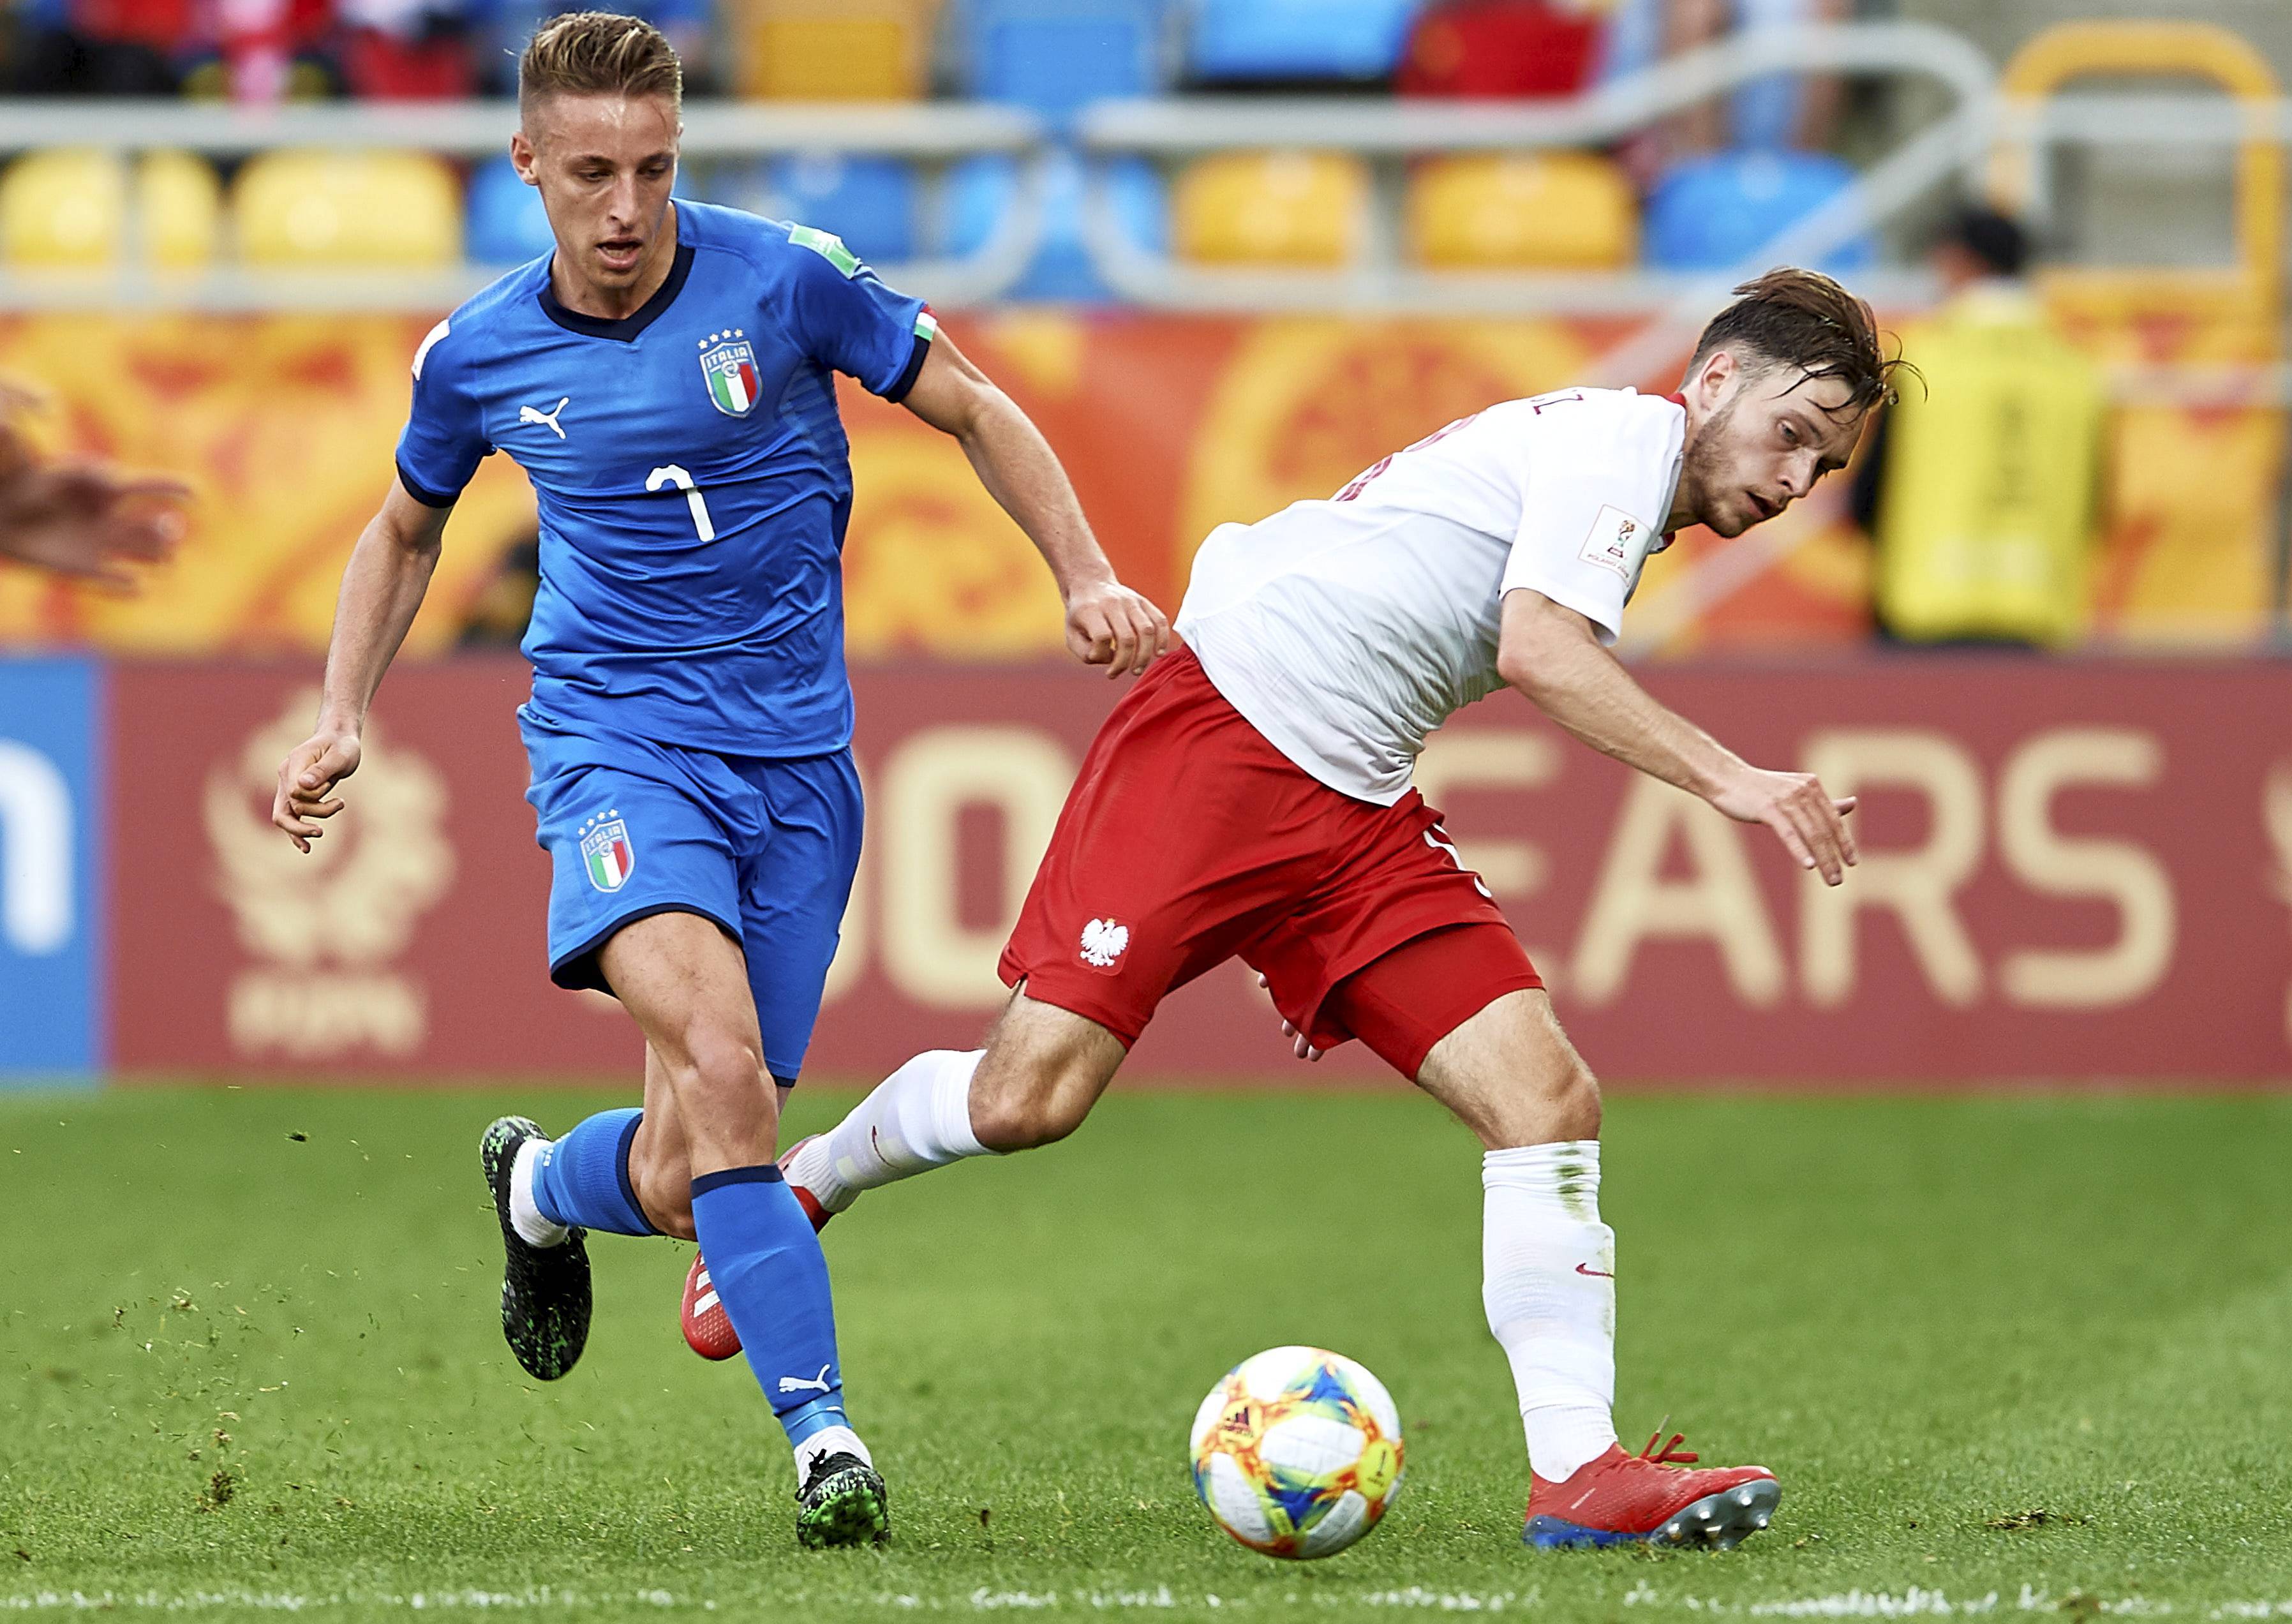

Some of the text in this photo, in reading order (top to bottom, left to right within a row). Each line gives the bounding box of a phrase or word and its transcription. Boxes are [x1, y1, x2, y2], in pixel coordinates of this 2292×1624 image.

[706, 346, 748, 368] ITALIA
[645, 464, 715, 542] 7
[584, 826, 621, 853] ITALIA
[1413, 729, 2177, 1008] EARS
